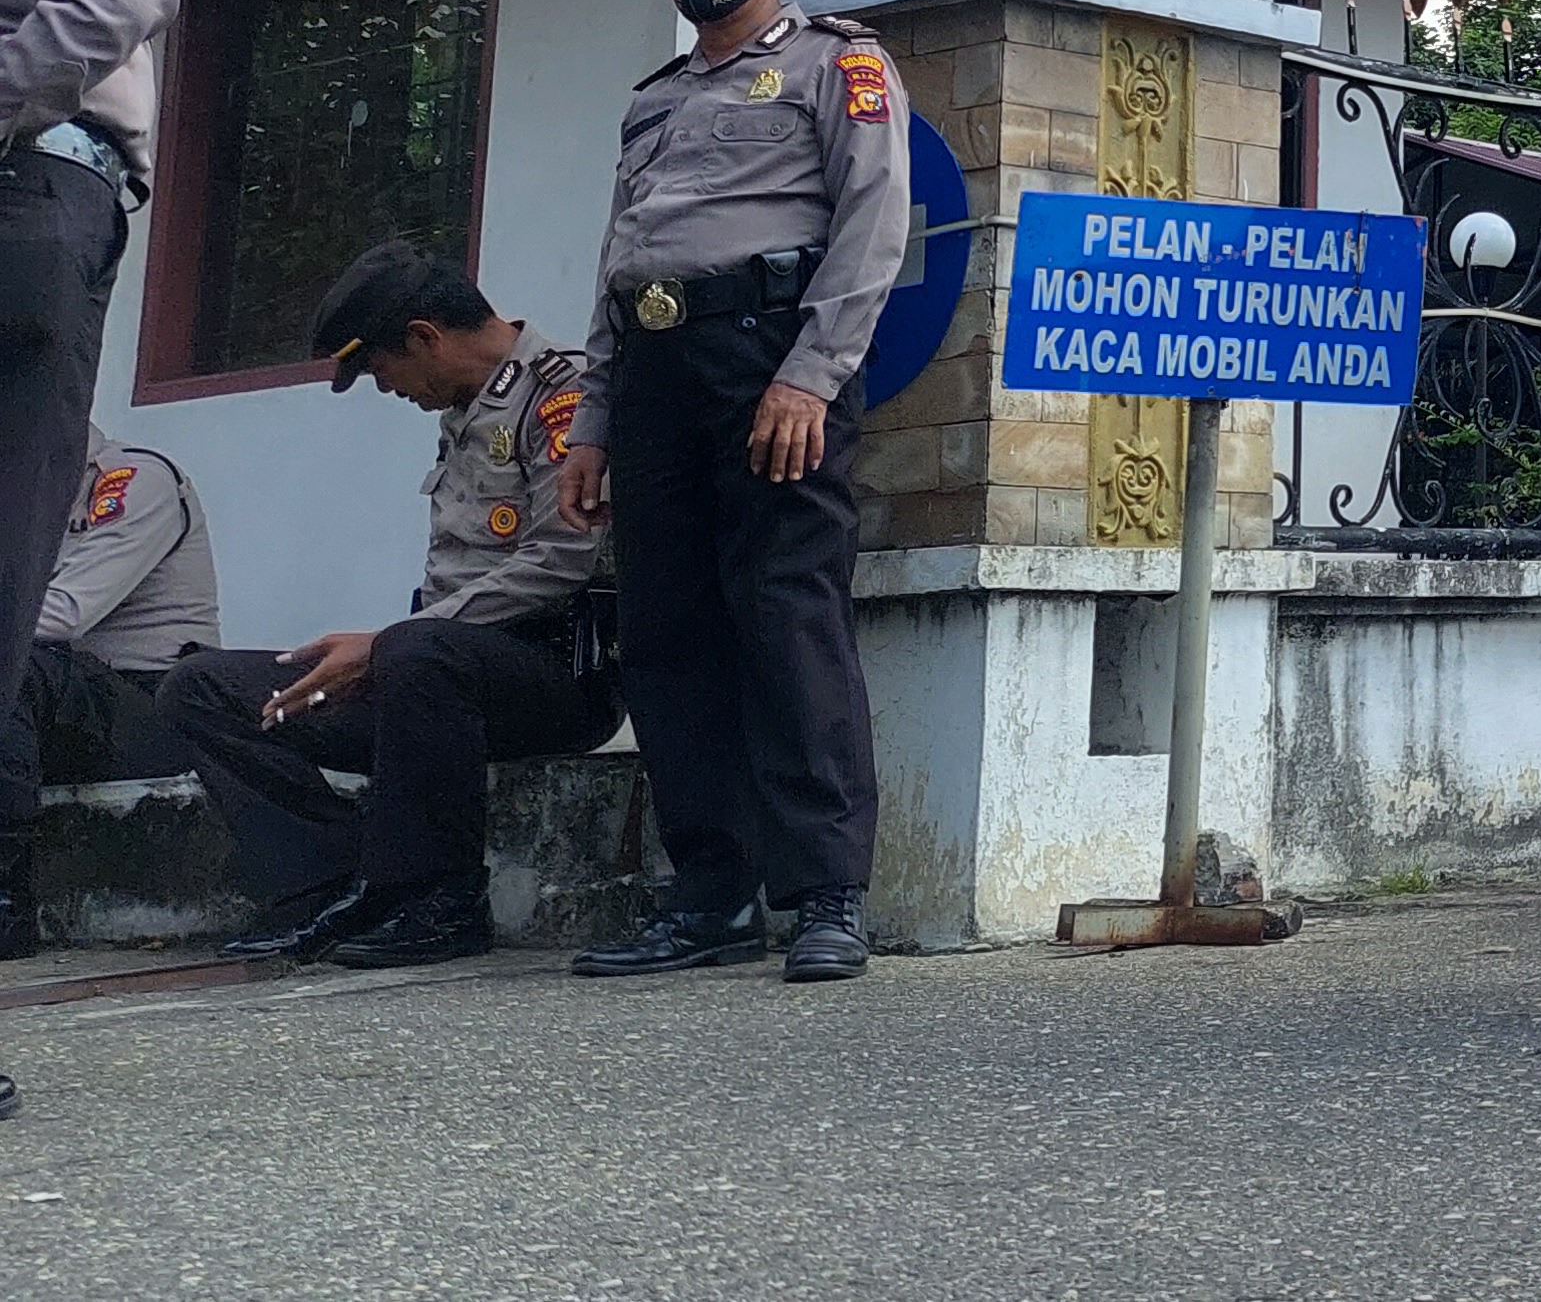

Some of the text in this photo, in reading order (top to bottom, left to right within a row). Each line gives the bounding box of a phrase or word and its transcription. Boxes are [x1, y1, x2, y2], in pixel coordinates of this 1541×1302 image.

[1083, 213, 1211, 264] PELAN
[1245, 224, 1368, 275] PELAN
[1030, 267, 1405, 332] MOHON TURUNKAN
[1033, 326, 1393, 388] KACA MOBIL ANDA
